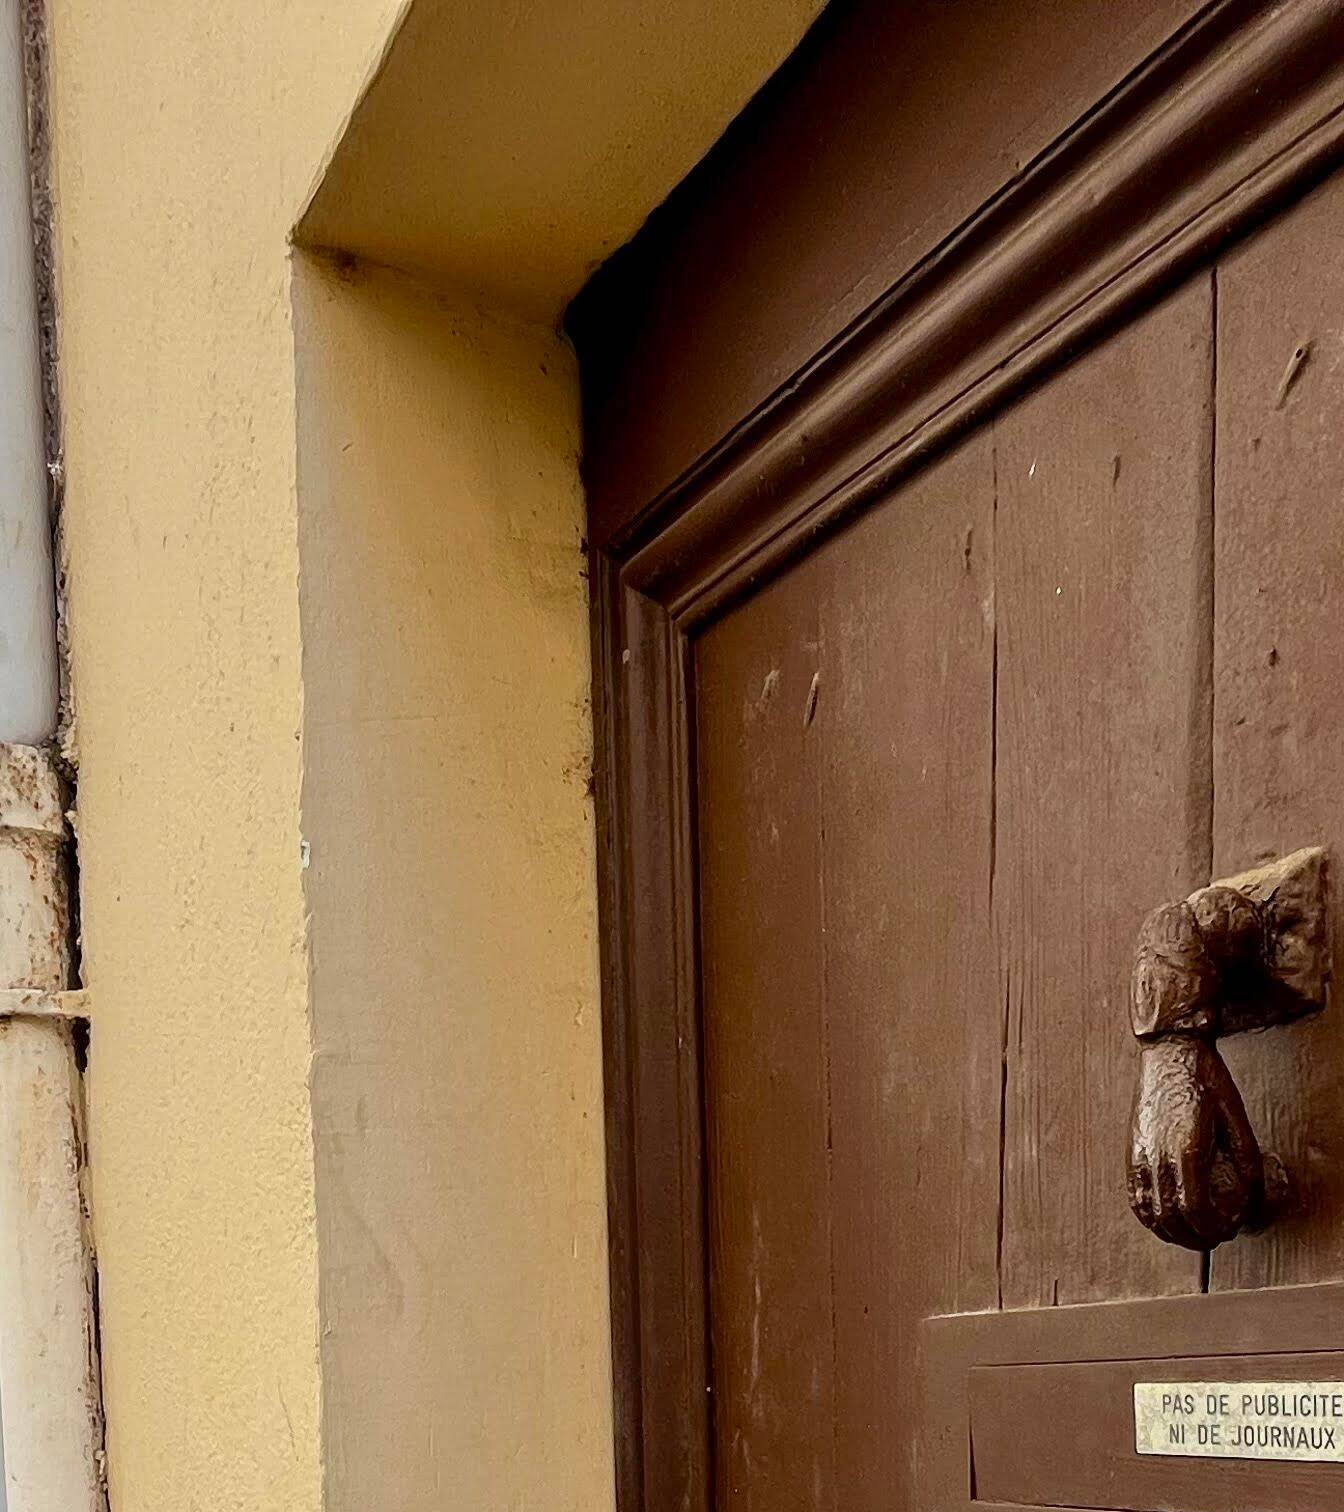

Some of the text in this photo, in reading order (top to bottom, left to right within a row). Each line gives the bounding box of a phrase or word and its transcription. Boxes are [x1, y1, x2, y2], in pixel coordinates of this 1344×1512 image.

[1162, 1393, 1344, 1417] PAS DE PUBLICITE
[1169, 1424, 1337, 1450] NI DE JOURNAUX
